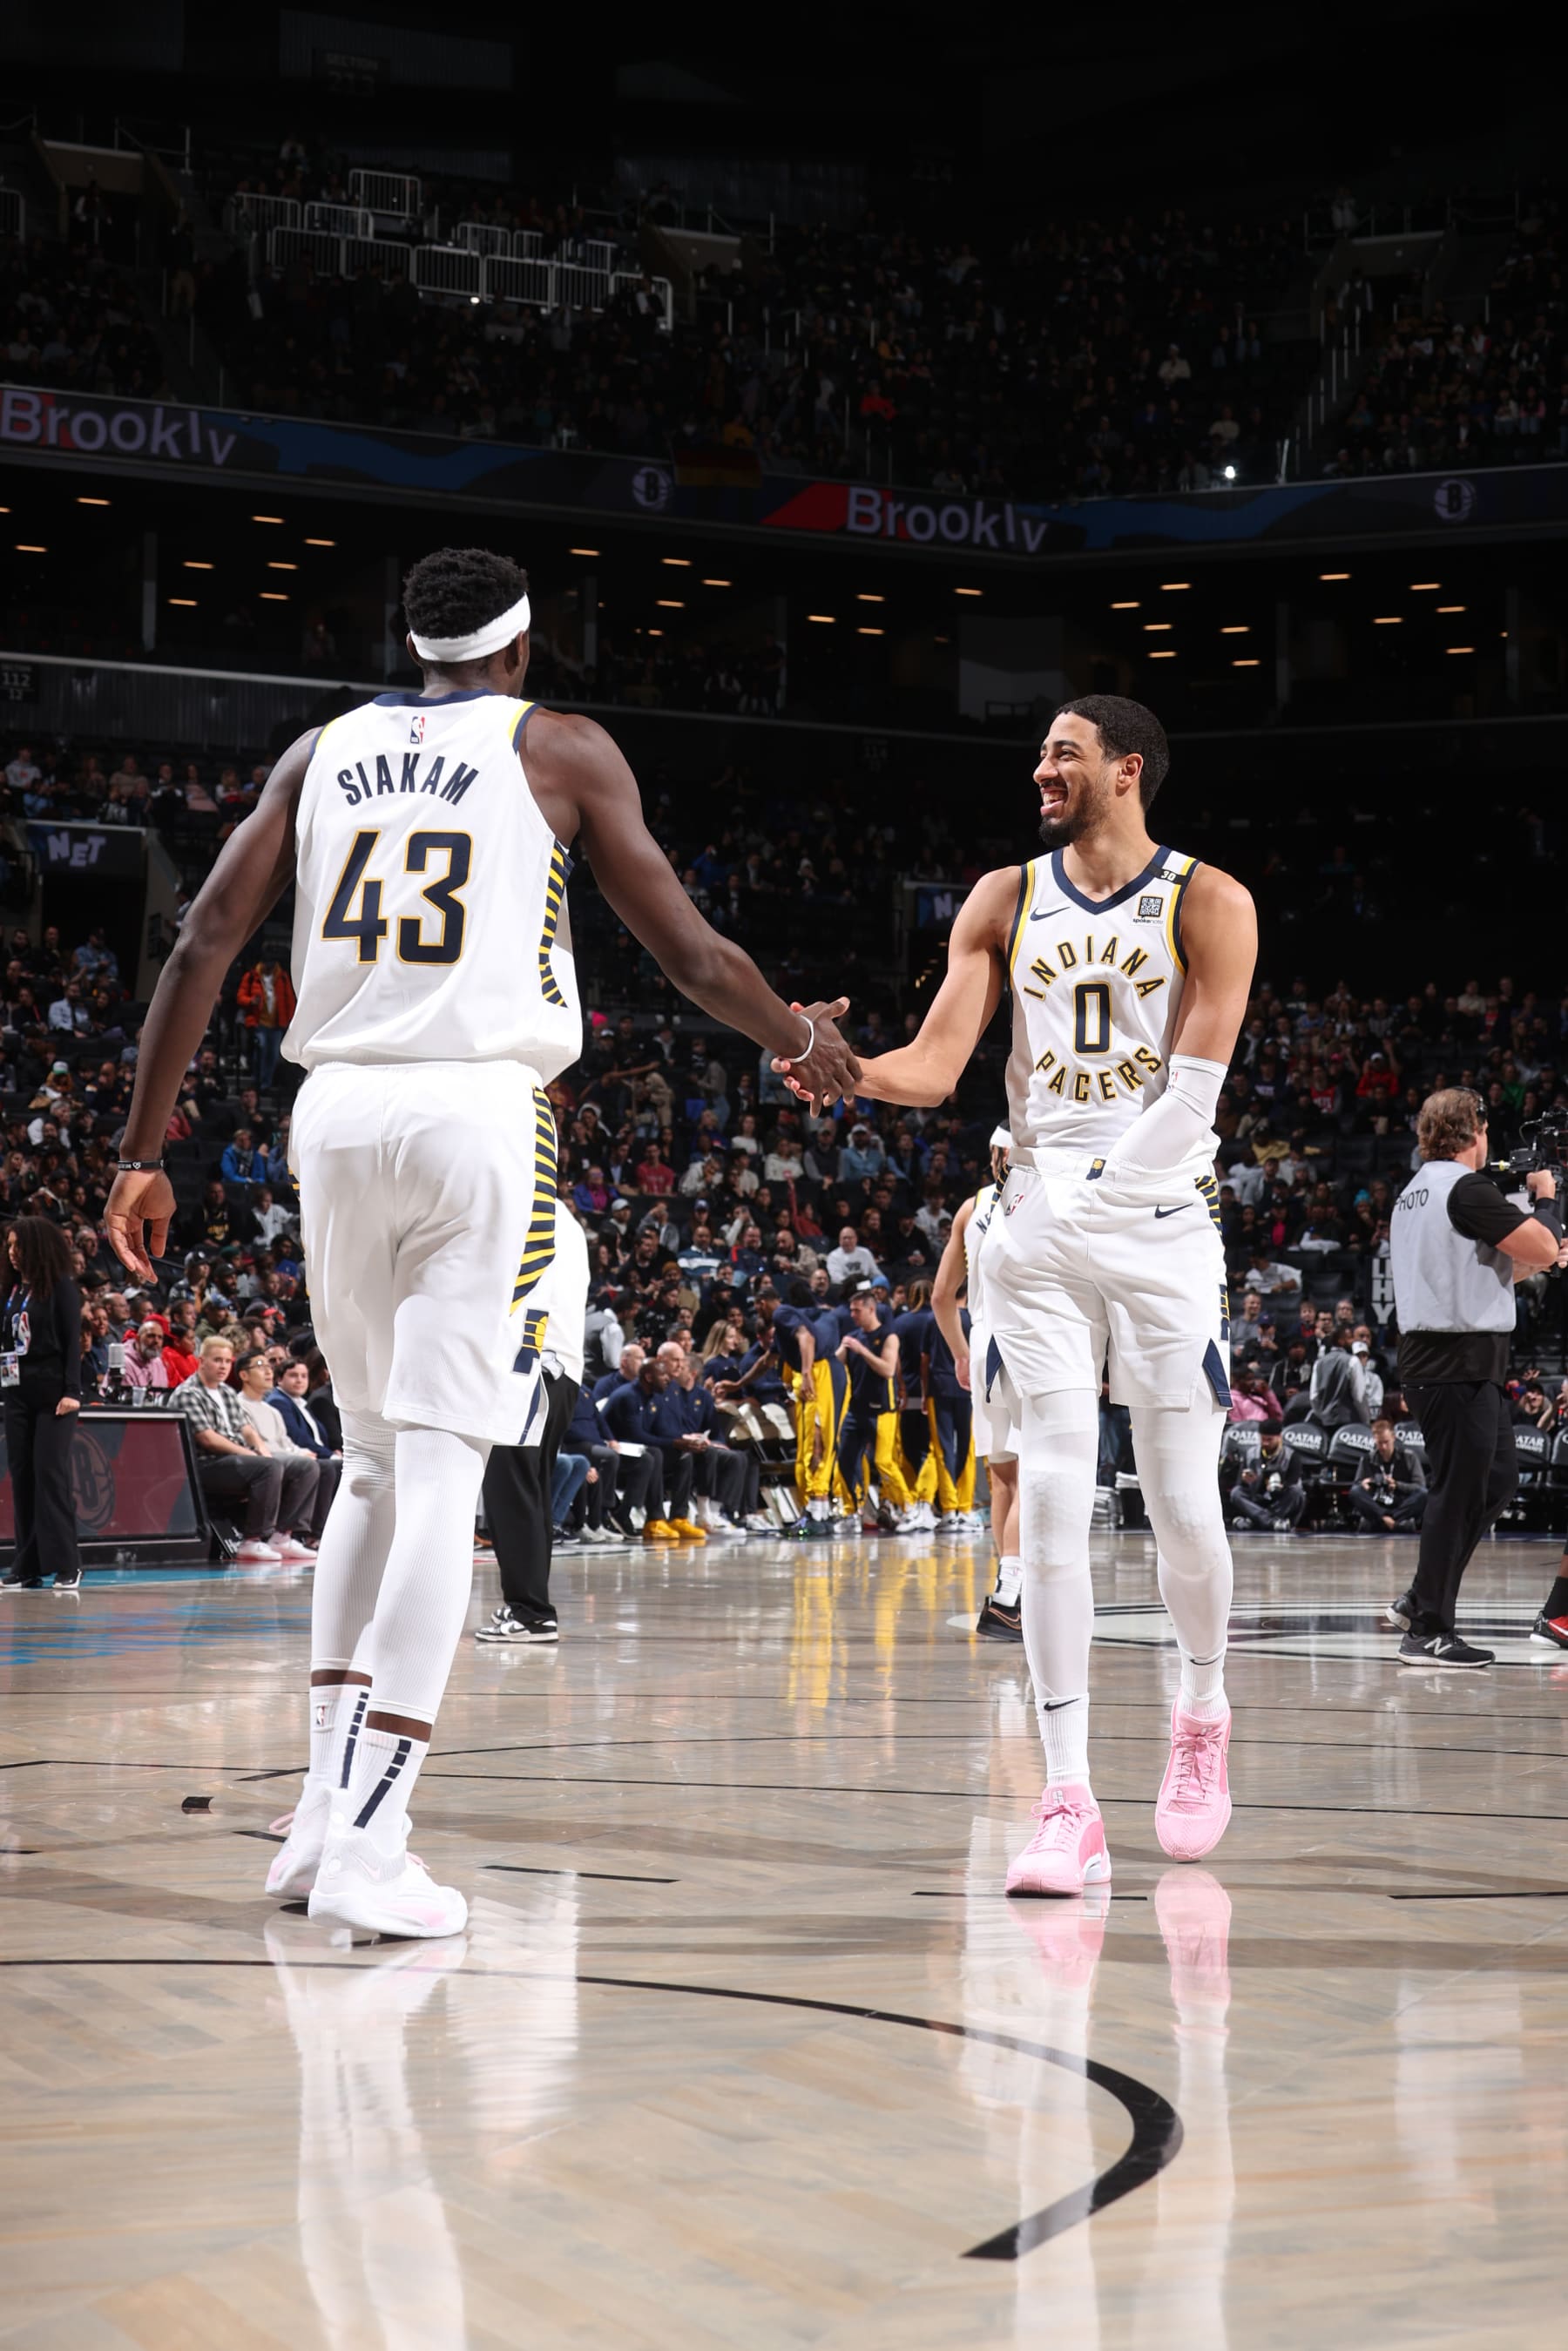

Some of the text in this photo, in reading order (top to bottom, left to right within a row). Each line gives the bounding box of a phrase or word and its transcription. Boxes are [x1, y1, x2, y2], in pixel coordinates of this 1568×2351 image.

[337, 753, 479, 806] SIAKAM
[47, 831, 106, 867] NET
[321, 829, 474, 966] 43
[1161, 870, 1177, 882] 30
[1024, 934, 1167, 1001] INDIANA
[1073, 980, 1112, 1056] 0
[1035, 1046, 1163, 1103] PACERS
[1284, 1431, 1322, 1445] QATAR
[1515, 1435, 1544, 1447] ATAR
